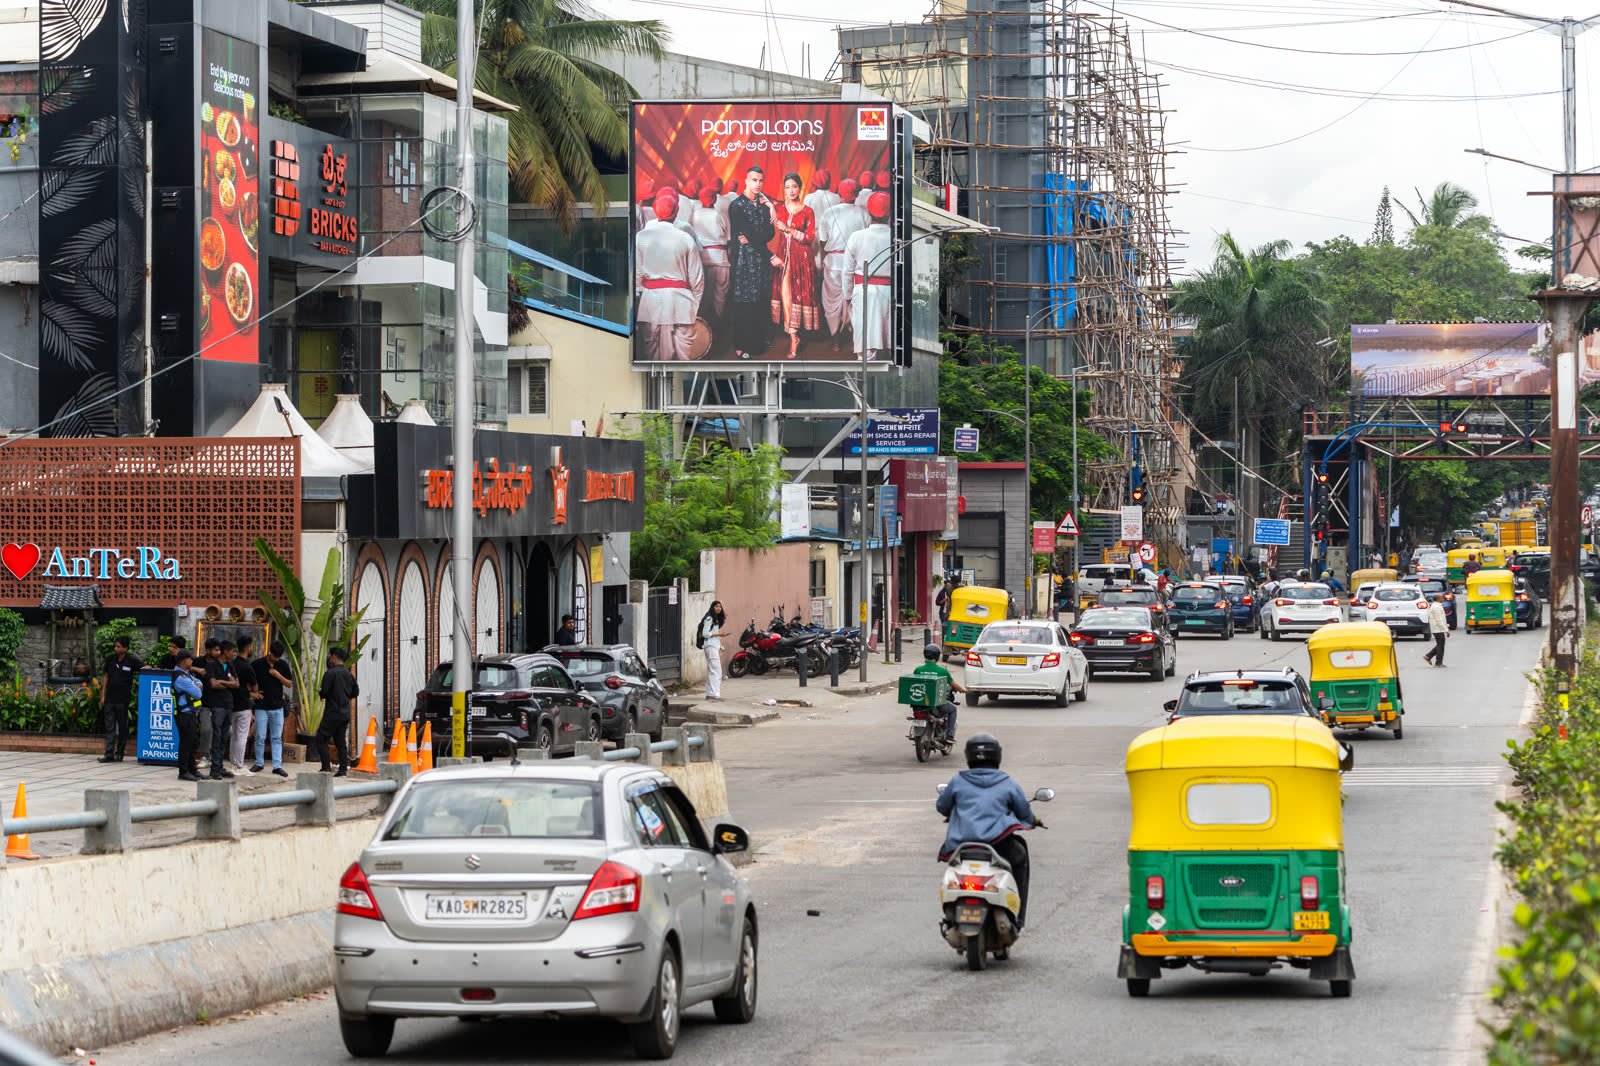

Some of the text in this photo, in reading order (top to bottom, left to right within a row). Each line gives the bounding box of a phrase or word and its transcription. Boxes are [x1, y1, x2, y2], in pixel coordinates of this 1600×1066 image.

[210, 63, 250, 87] End the year on a
[213, 80, 234, 96] delicious
[310, 208, 358, 242] BRICKS
[42, 546, 182, 580] AnTeRa
[152, 682, 172, 696] An
[152, 698, 172, 713] Te
[153, 714, 170, 728] Ra
[148, 742, 175, 750] VALET
[142, 750, 179, 759] PARKING
[436, 898, 524, 914] KA03MR2825
